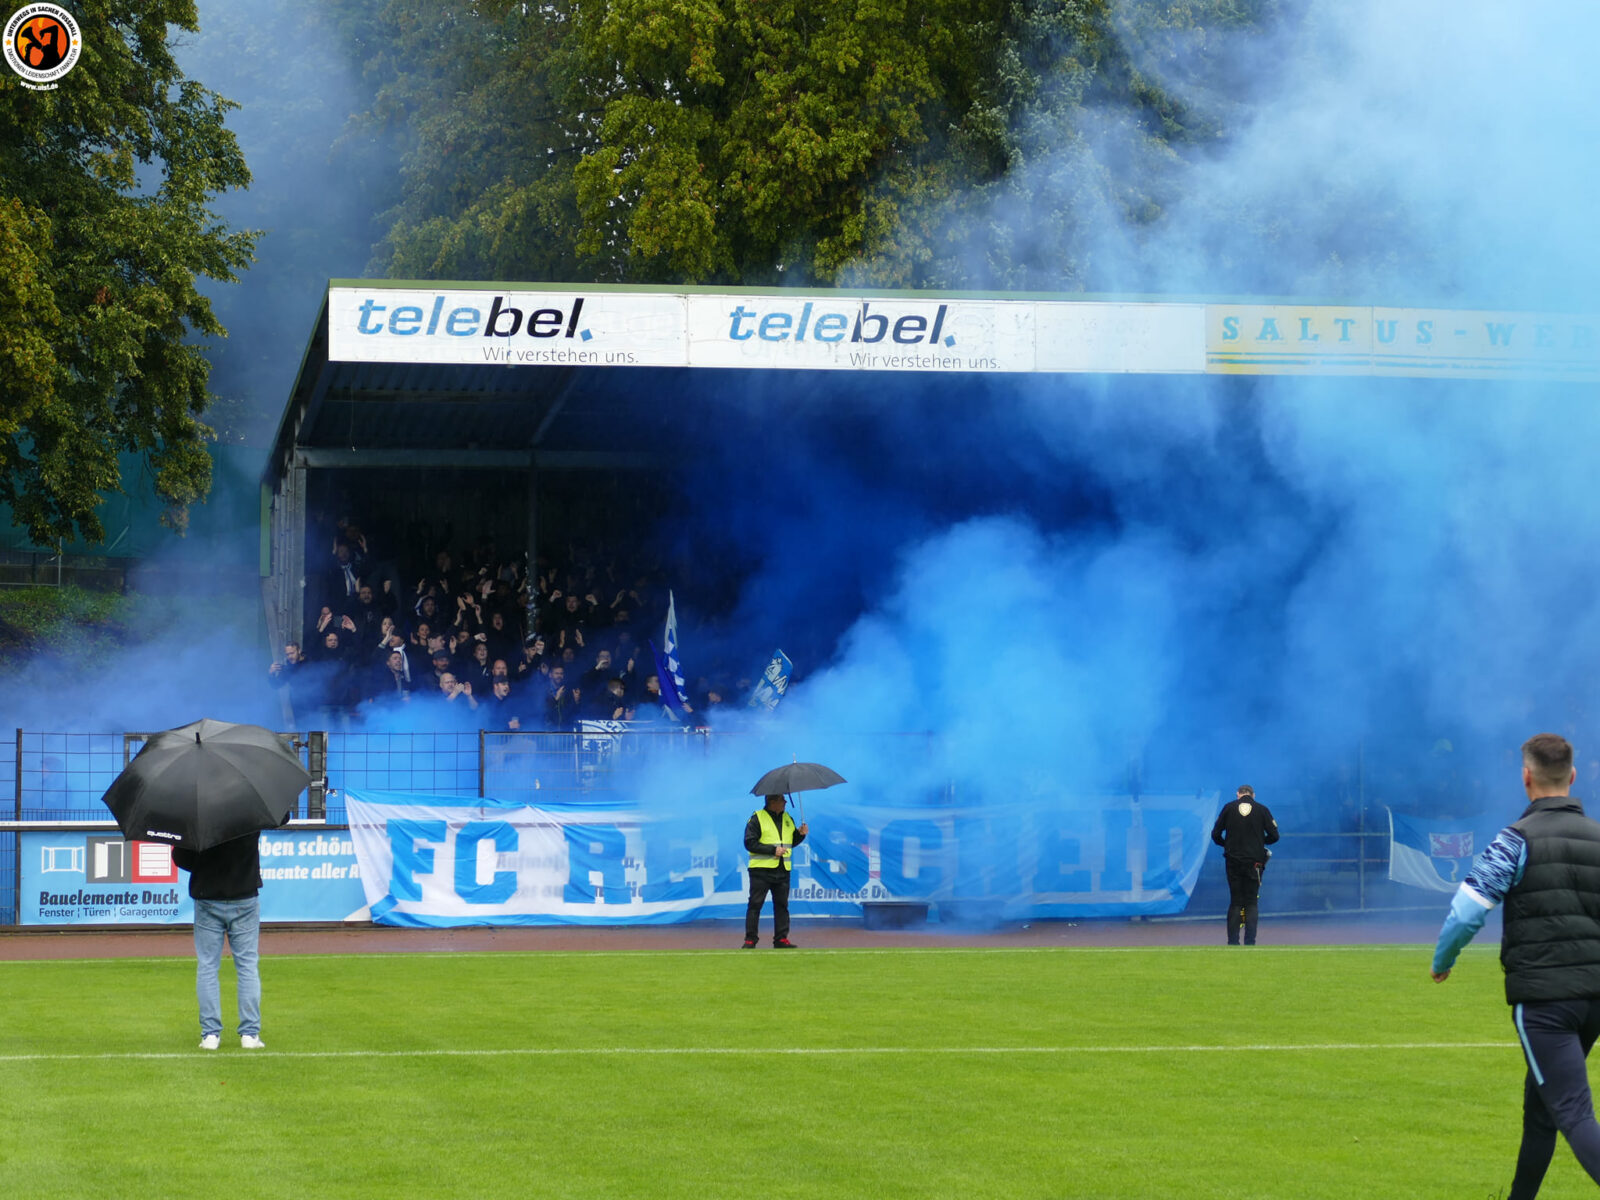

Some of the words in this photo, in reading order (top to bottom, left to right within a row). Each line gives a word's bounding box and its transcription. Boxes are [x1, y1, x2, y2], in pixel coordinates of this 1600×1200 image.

[483, 346, 511, 361] Wir
[517, 347, 599, 363] verstehen
[605, 350, 639, 364] uns.
[850, 352, 878, 368] Wir
[882, 353, 962, 369] verstehen
[968, 356, 1001, 370] uns.
[147, 830, 182, 841] quattro
[258, 835, 295, 857] ben
[298, 834, 357, 856] schön
[386, 818, 519, 904] FC
[259, 865, 309, 880] mente
[311, 862, 348, 880] aller
[40, 889, 138, 906] Bauelemente
[142, 889, 179, 905] Duck
[39, 907, 74, 917] Fenster
[83, 906, 111, 917] Türen
[120, 906, 179, 918] Garagentore
